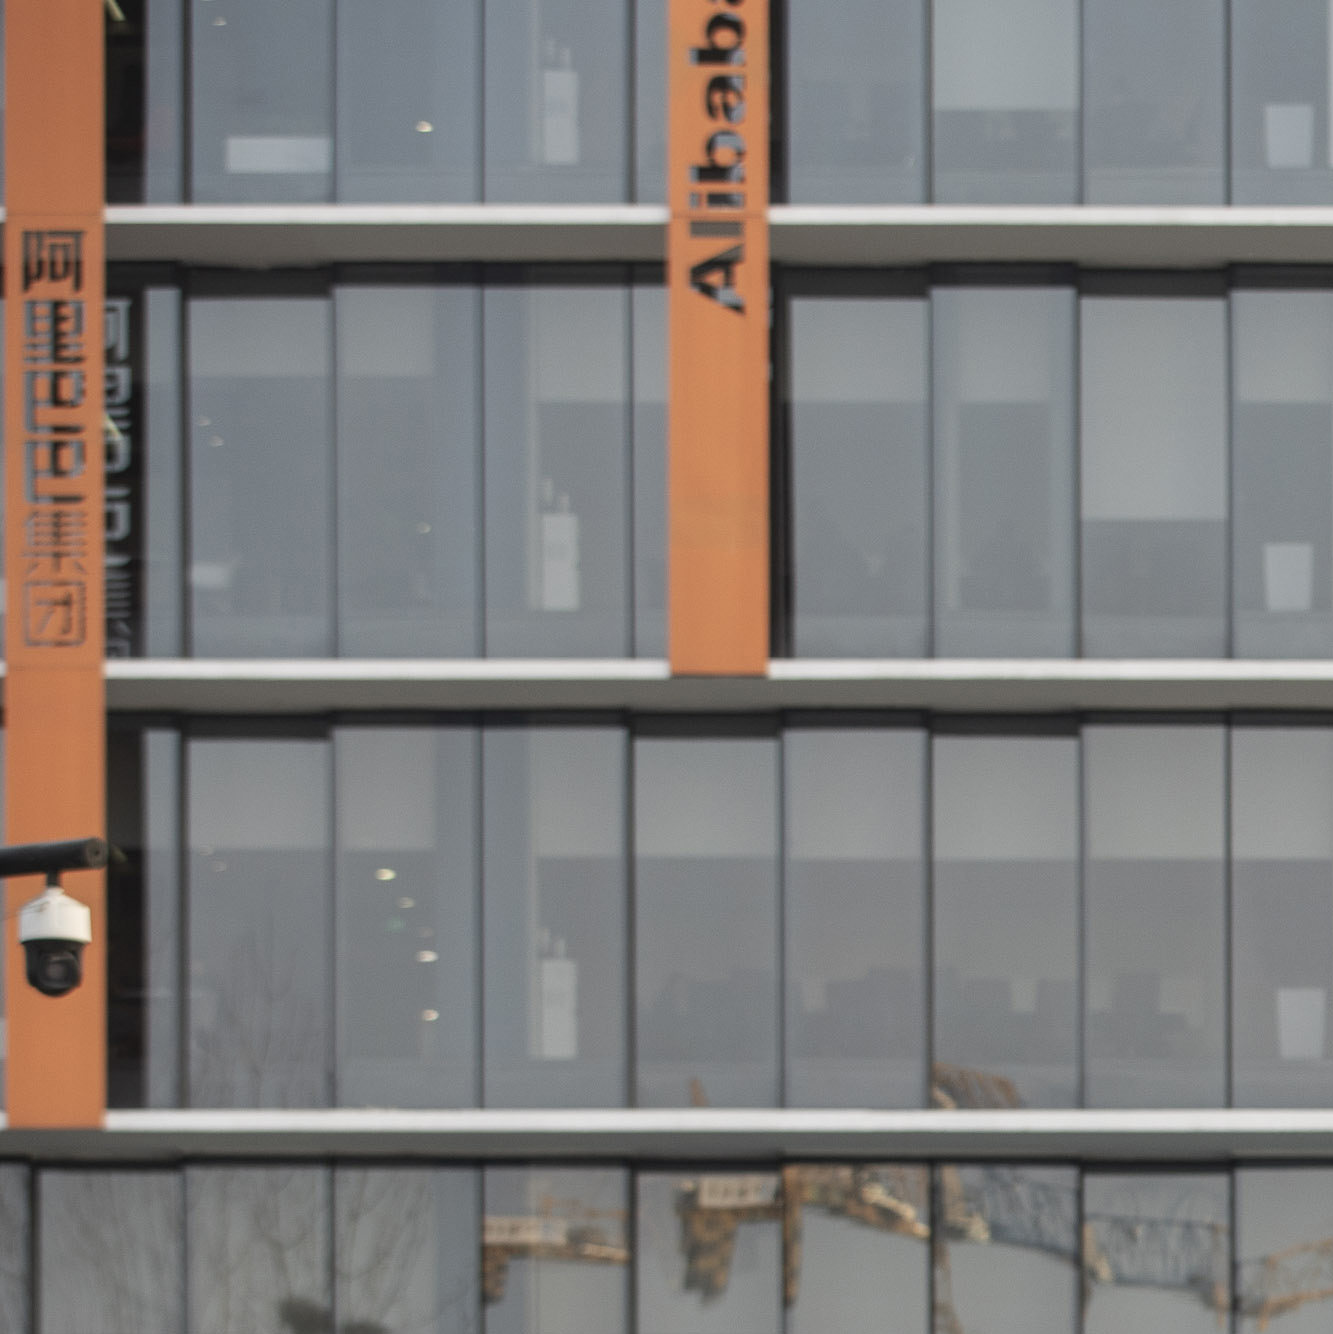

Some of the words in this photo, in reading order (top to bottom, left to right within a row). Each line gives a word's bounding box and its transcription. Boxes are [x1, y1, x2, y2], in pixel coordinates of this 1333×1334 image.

[689, 0, 747, 315] Alibab
[22, 230, 87, 648] 阿里巴巴集团
